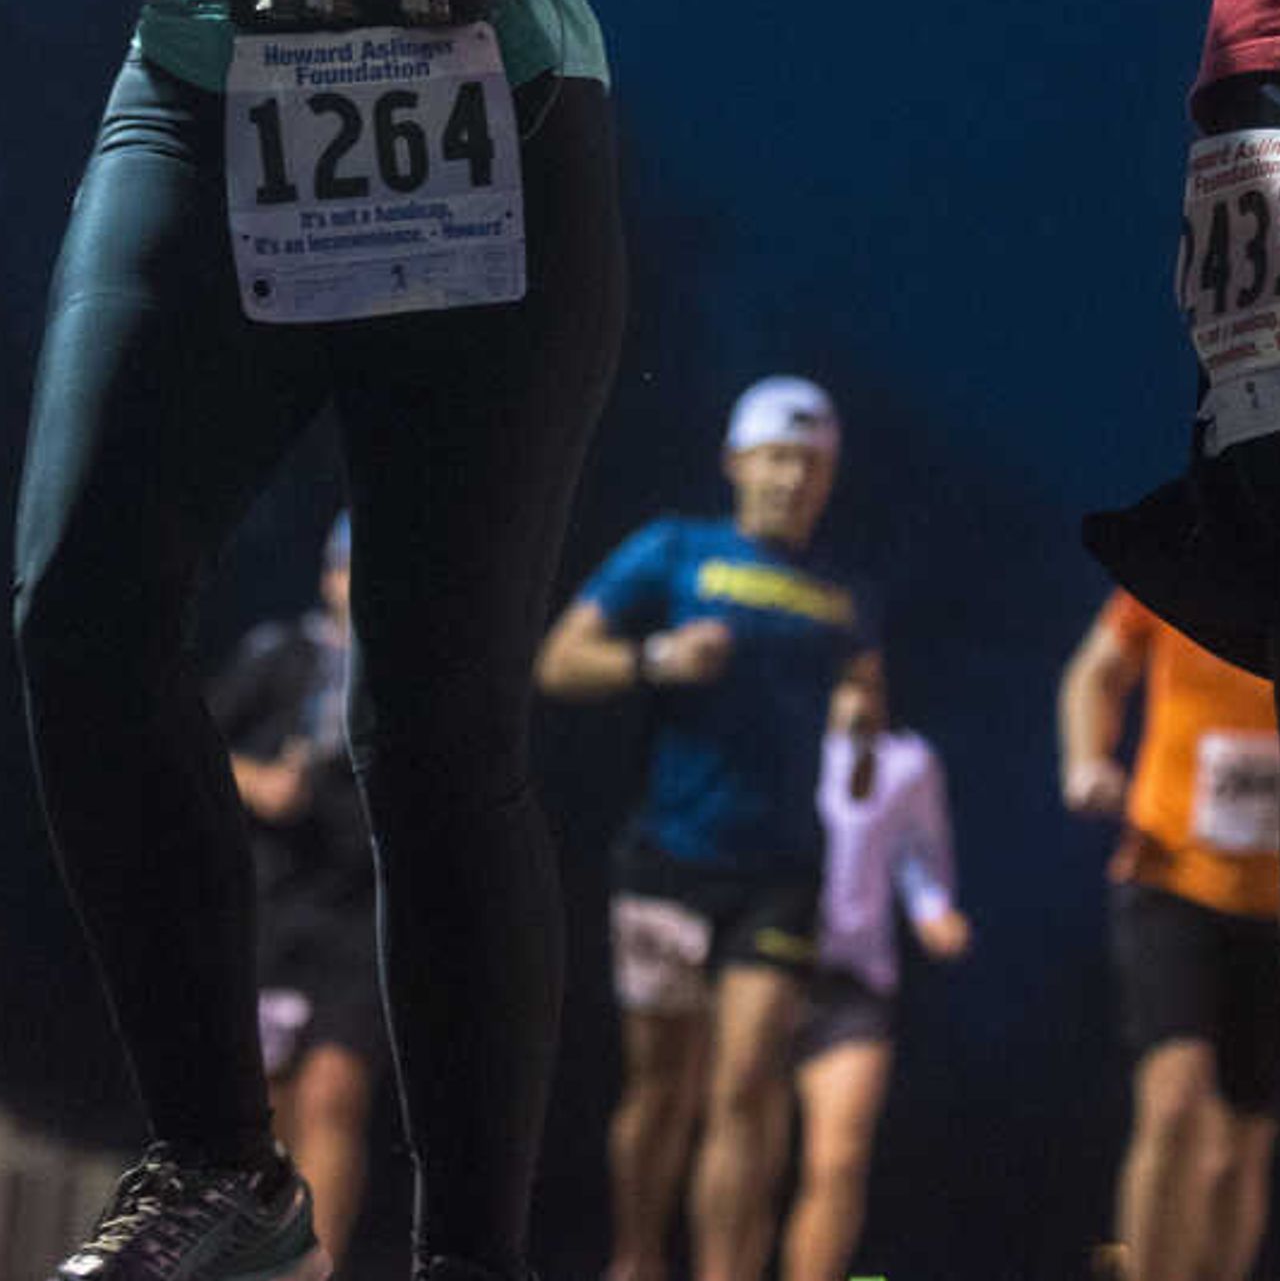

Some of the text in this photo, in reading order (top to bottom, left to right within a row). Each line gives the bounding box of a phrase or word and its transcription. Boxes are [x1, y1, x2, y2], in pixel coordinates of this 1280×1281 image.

[265, 38, 453, 66] Howard Aslinger
[296, 60, 430, 85] Foundation
[248, 81, 496, 205] 1264
